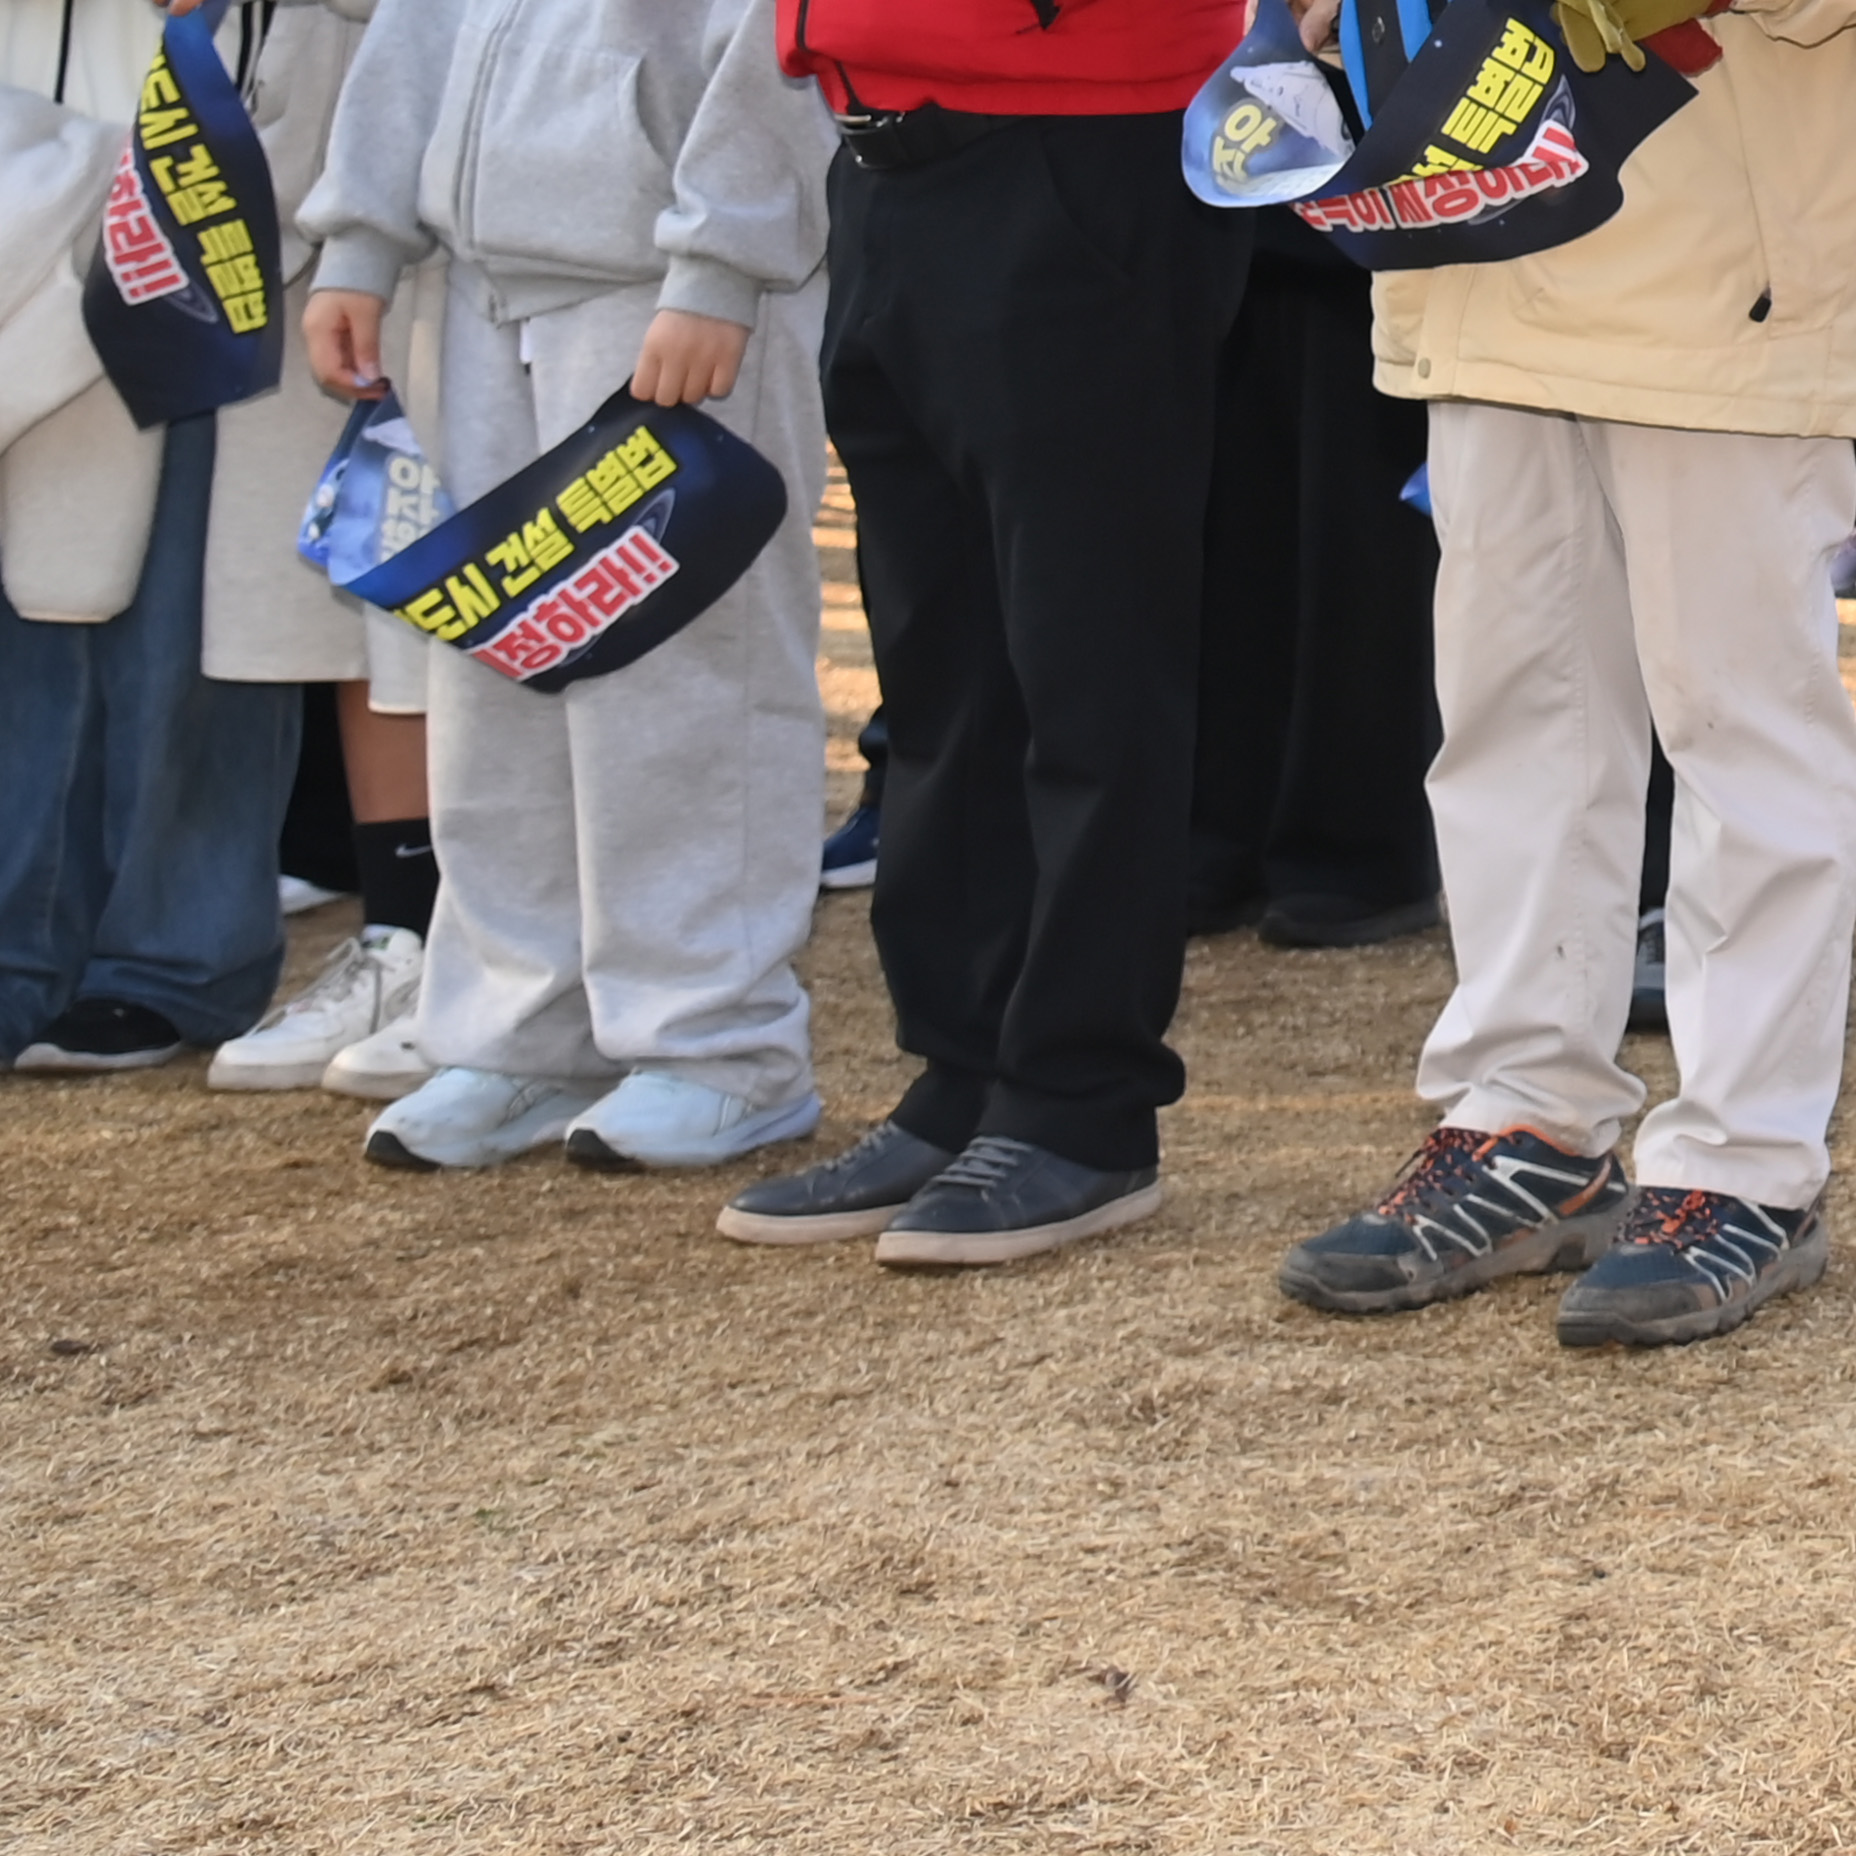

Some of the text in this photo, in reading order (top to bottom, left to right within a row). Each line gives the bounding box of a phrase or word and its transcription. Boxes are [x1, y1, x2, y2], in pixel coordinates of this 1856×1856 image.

[1441, 16, 1555, 154] 특별법
[149, 143, 238, 227] 건설
[196, 218, 268, 334] 특별법
[393, 425, 678, 641] 도시 건설 특별법
